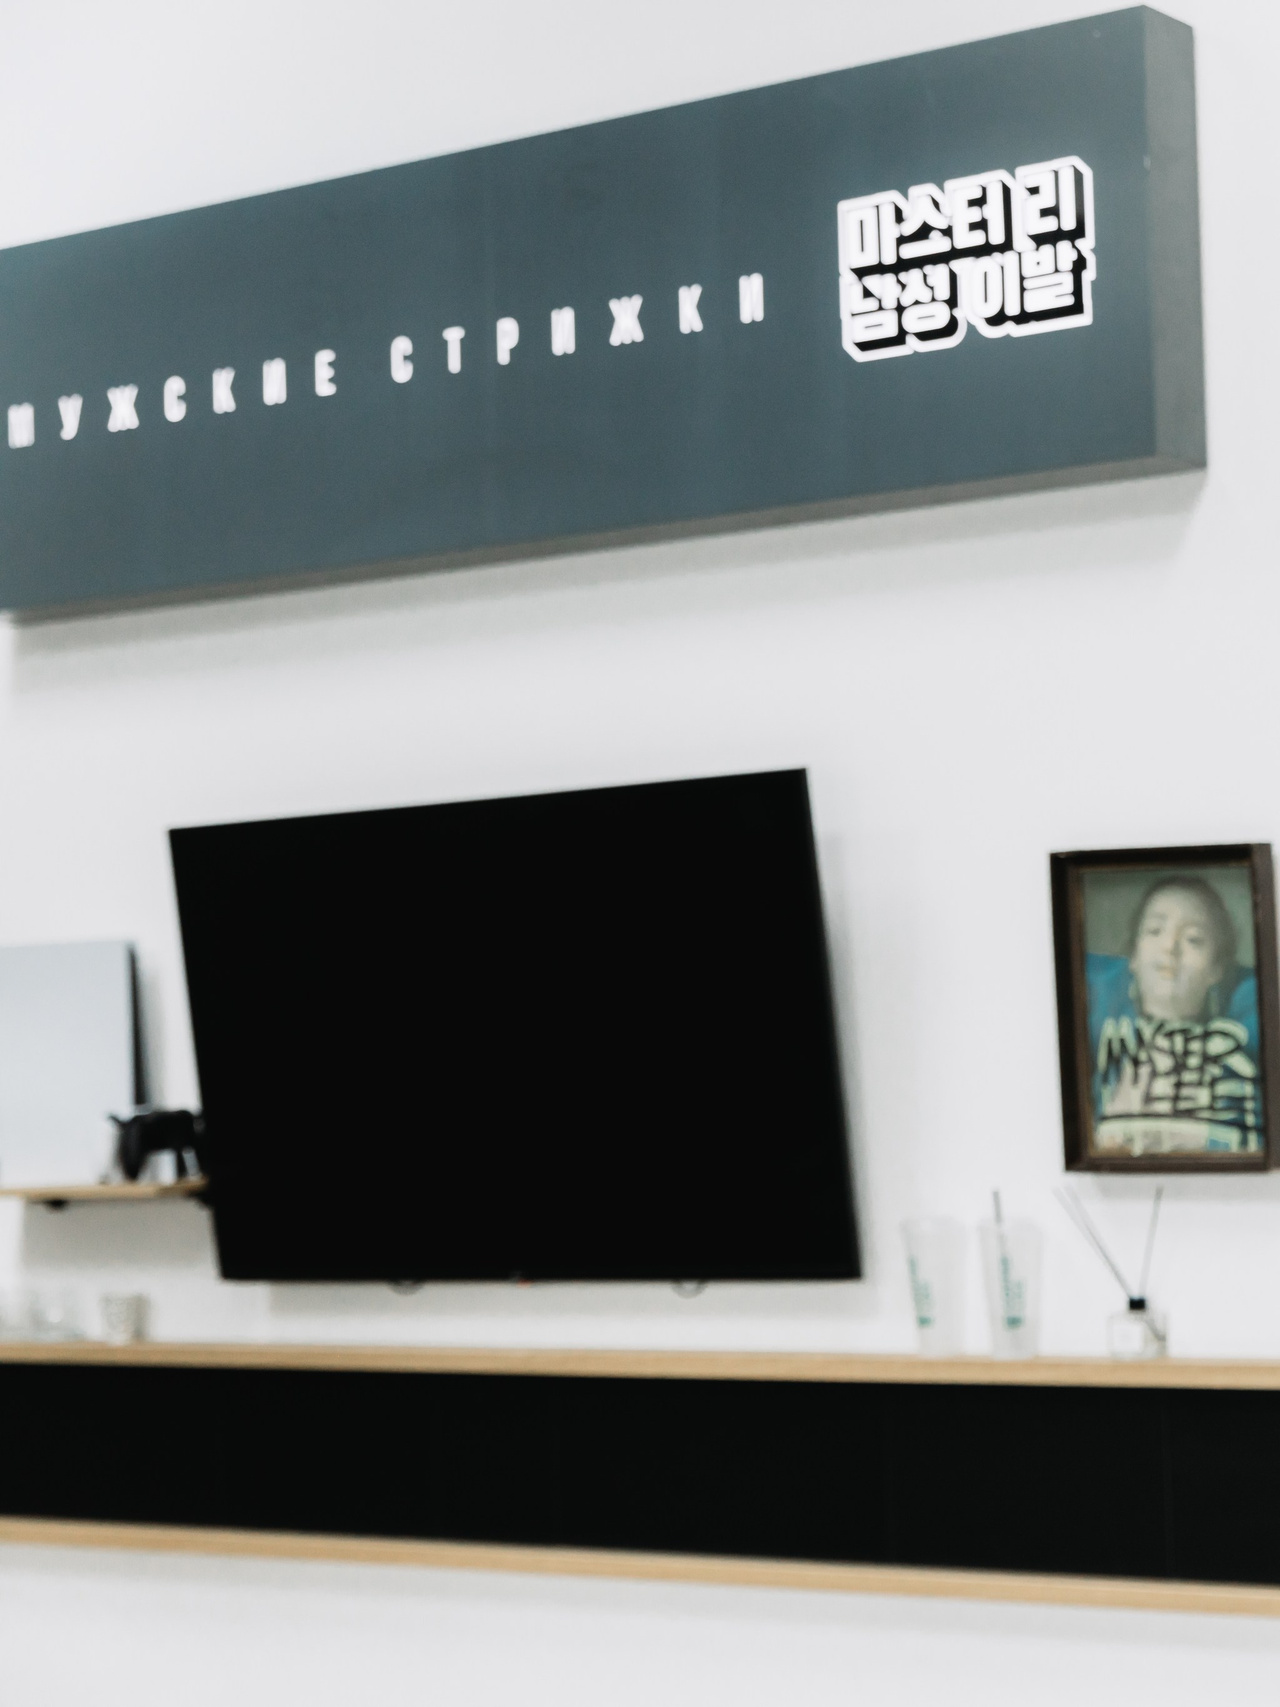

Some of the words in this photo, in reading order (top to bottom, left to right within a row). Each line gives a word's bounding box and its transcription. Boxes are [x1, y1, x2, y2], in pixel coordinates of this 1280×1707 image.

[849, 178, 1006, 269] 마스터
[1023, 164, 1077, 236] 리
[850, 263, 951, 343] 남성
[964, 240, 1078, 317] 이발
[7, 348, 337, 449] МУЖСКИЕ
[390, 272, 764, 383] СТРИЖКИ
